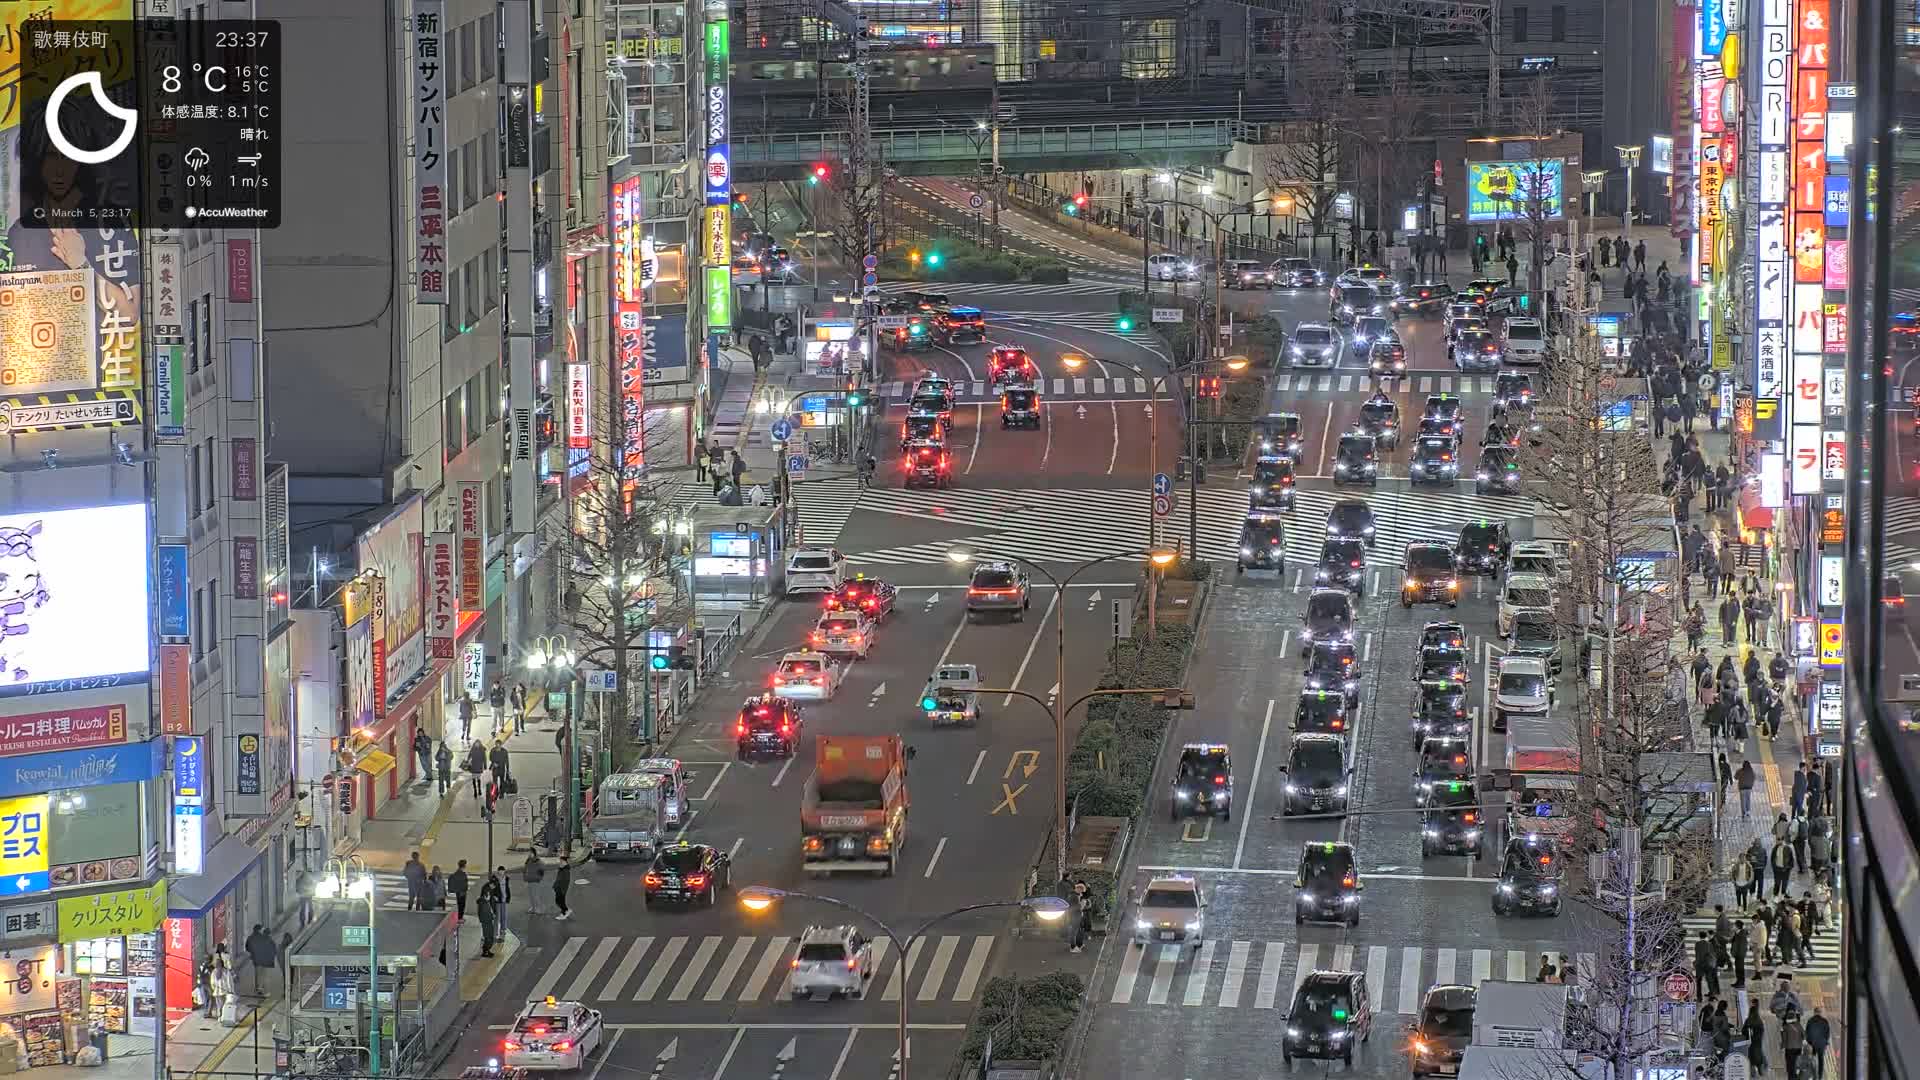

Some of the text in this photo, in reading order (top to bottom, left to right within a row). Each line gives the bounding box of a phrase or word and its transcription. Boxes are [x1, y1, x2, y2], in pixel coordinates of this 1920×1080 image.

[417, 13, 442, 292] 新宿サンパーク 三平本館
[623, 332, 639, 388] ラーメン
[1761, 331, 1774, 383] 大衆酒場
[159, 355, 170, 416] FamilyMart
[1797, 311, 1820, 470] パセラ
[15, 404, 113, 423] テンクリ たいせい先生
[516, 408, 529, 460] HOMEGAME
[463, 488, 473, 531] GAME
[375, 583, 383, 620] 389
[434, 544, 450, 630] 三平ストア
[467, 682, 478, 690] 4F
[111, 712, 120, 737] 5F
[27, 736, 71, 748] RESTAURANT
[2, 812, 41, 837] プロ
[3, 837, 41, 859] ミス
[6, 912, 41, 933] 囲碁
[72, 903, 143, 928] クリスタル
[328, 992, 344, 1005] 12
